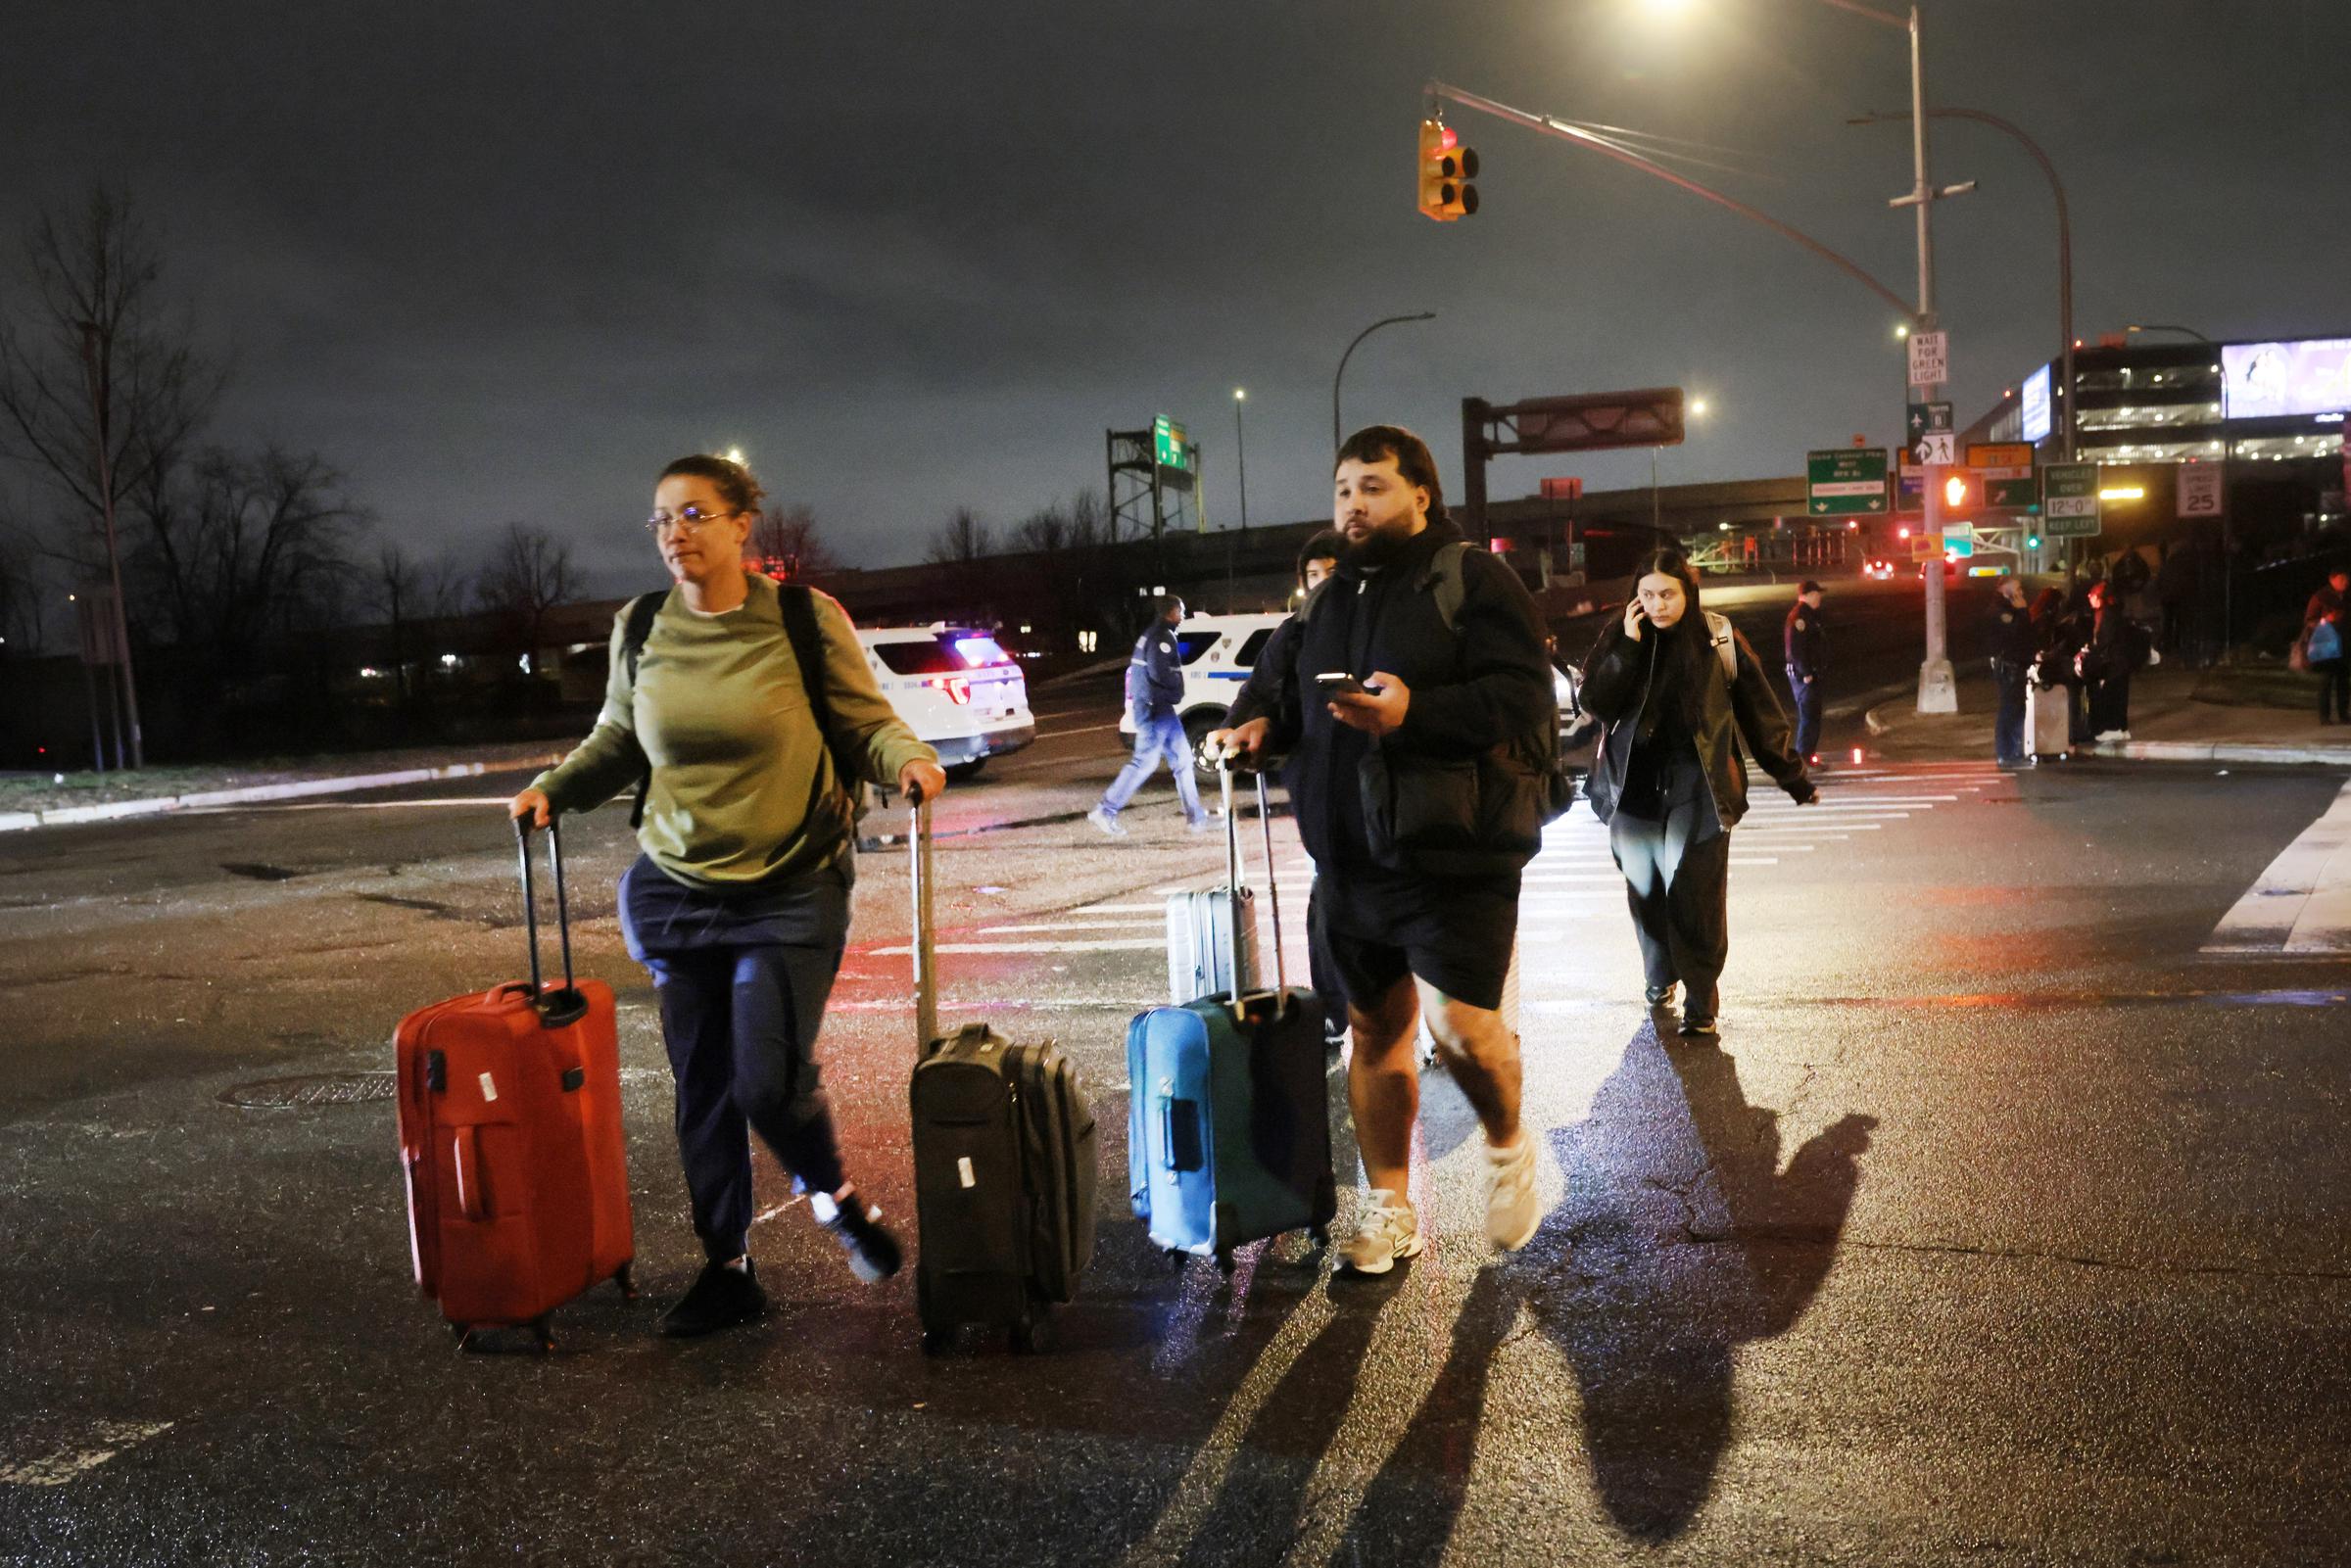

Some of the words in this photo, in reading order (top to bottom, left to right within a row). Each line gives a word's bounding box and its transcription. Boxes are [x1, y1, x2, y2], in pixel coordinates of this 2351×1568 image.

[1916, 334, 1939, 346] WAIT
[1917, 346, 1938, 357] FOR
[1912, 357, 1944, 370] GREEN
[1913, 369, 1942, 382] LIGHT
[2059, 483, 2084, 493] OVER
[2186, 494, 2215, 511] 25
[2048, 520, 2072, 531] KEEP
[2074, 518, 2094, 530] LEFT
